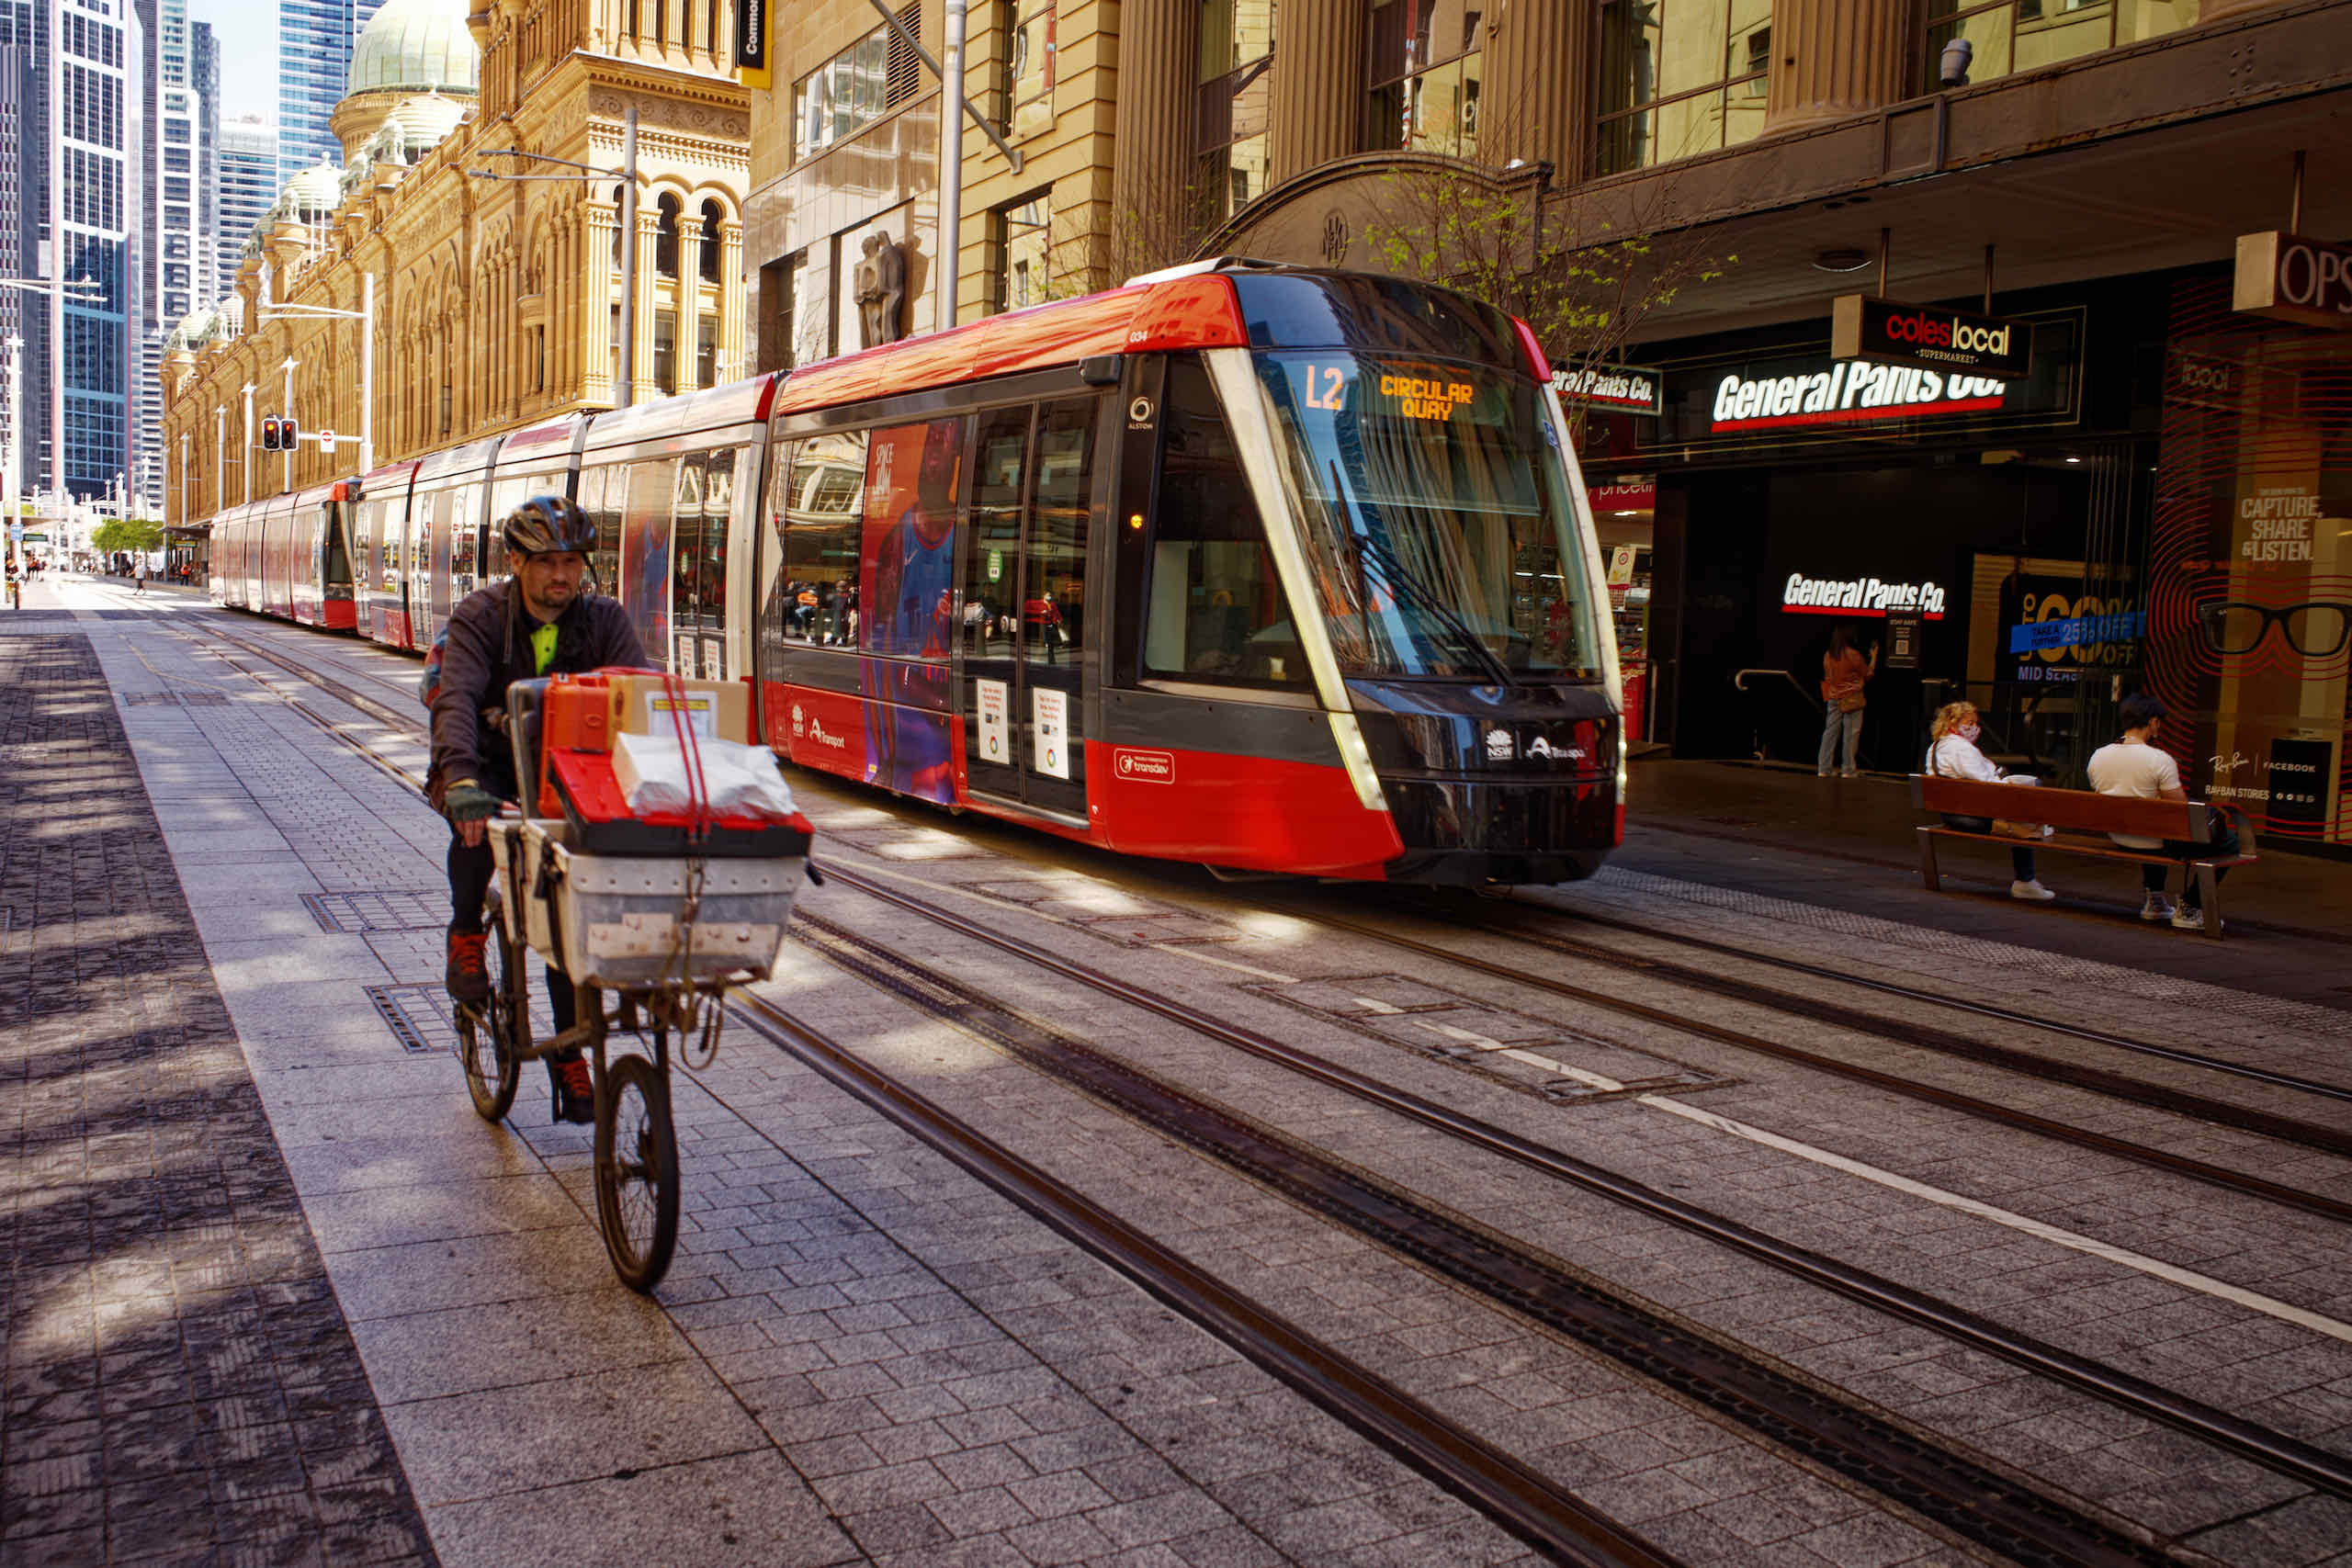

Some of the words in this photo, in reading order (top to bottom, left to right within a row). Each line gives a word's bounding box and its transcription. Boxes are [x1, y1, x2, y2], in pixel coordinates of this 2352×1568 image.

[1306, 365, 1343, 411] L2
[1381, 375, 1473, 404] CIRCULAR
[1584, 370, 1629, 399] Pants
[1629, 376, 1653, 401] Co.
[1713, 362, 1847, 422] General
[1840, 360, 1943, 409] Pants
[1402, 398, 1453, 421] QUAY
[2242, 496, 2324, 519] CAPTURE,
[2252, 519, 2309, 539] SHARE
[1784, 572, 1866, 608] General
[1863, 578, 1919, 611] Pants
[1918, 581, 1945, 614] Co.
[2018, 666, 2042, 681] MID
[1134, 761, 1170, 775] transdev
[2263, 761, 2316, 773] FACEBOOK
[2205, 784, 2236, 797] RAY-BAN
[2237, 787, 2270, 801] STORIES
